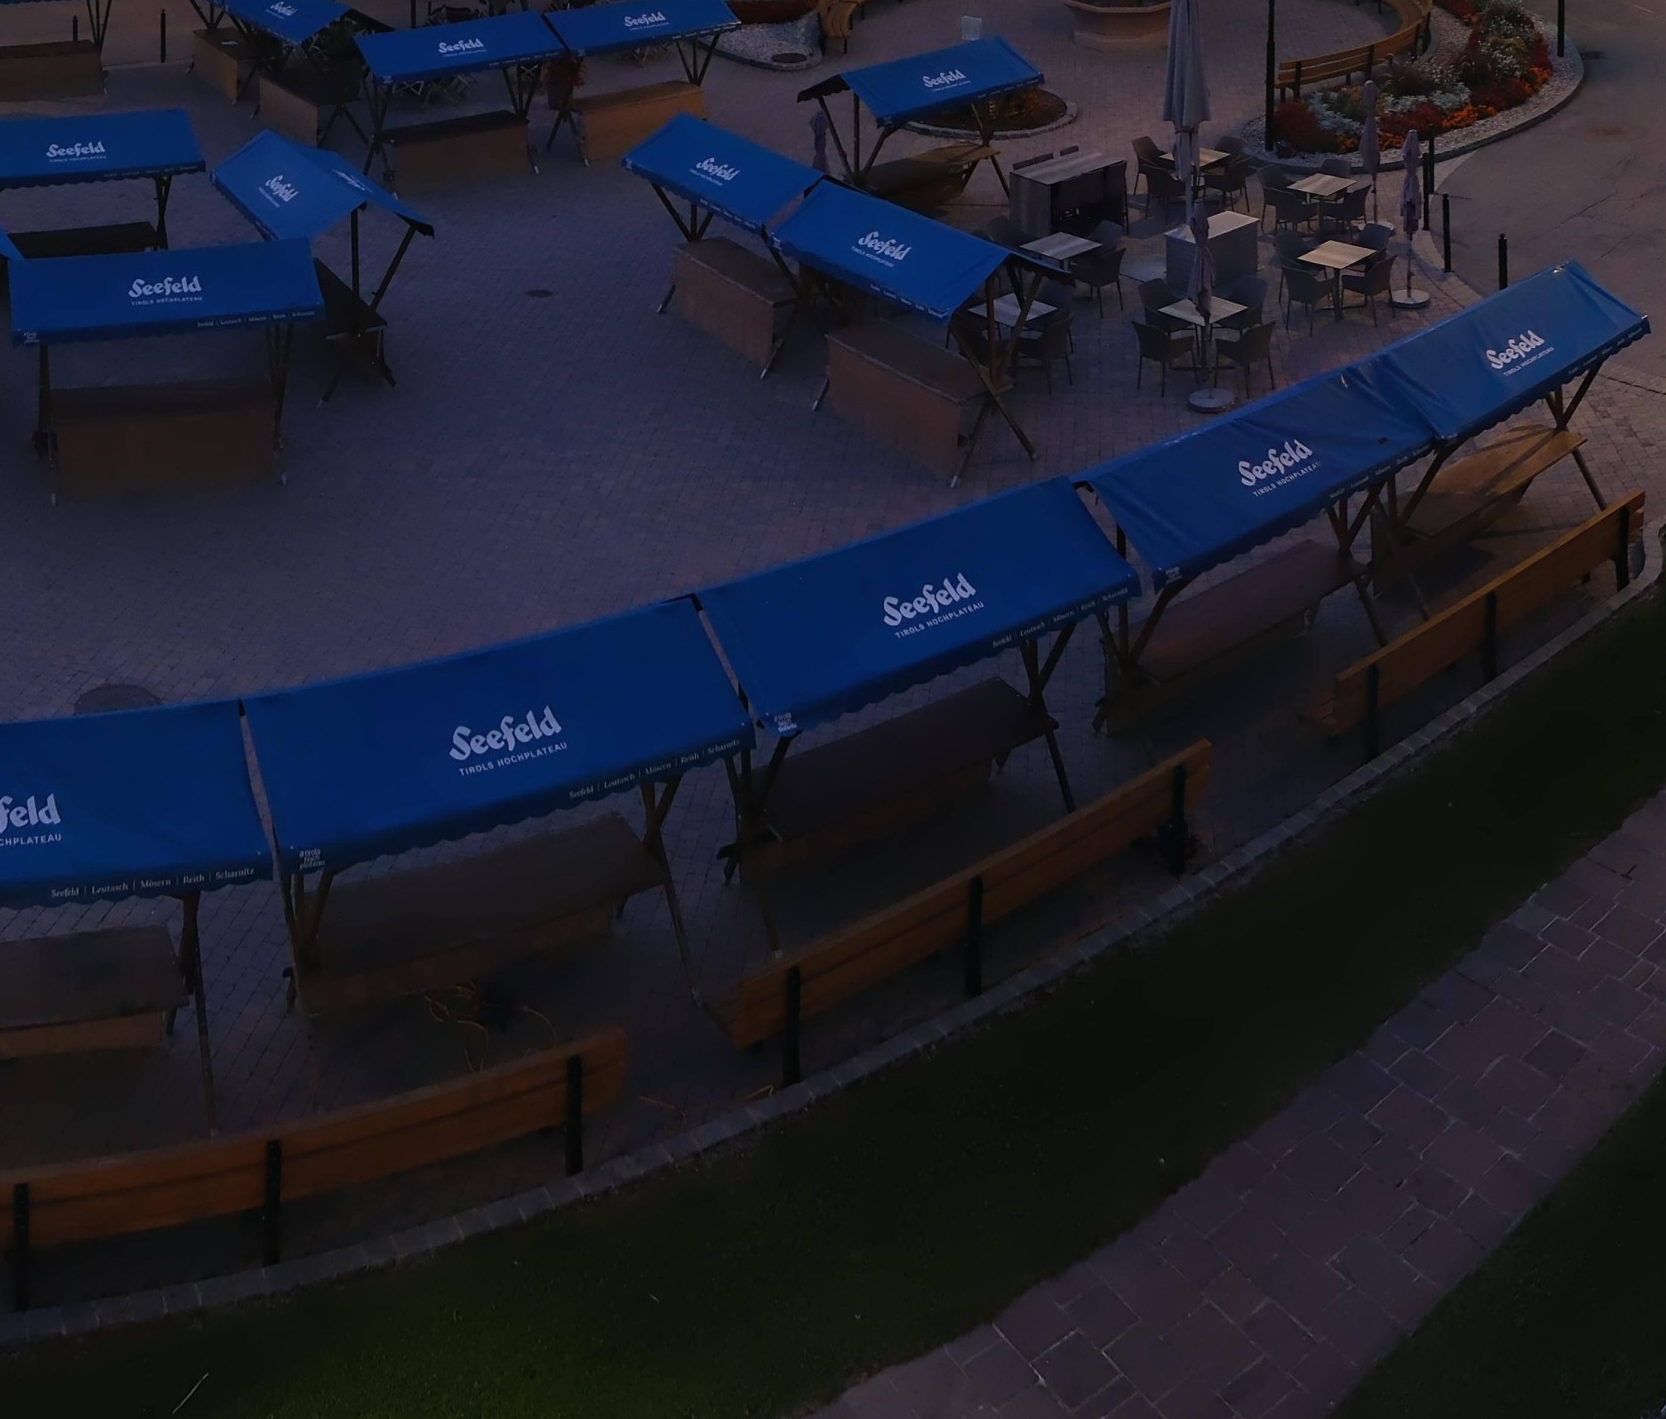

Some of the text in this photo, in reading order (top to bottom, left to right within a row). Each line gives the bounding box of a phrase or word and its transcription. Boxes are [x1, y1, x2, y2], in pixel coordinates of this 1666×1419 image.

[624, 11, 667, 27] Seefeld
[438, 38, 485, 53] Seefeld
[923, 69, 967, 88] Seefeld
[45, 141, 106, 157] Seefeld
[695, 157, 741, 181] Seefeld
[858, 231, 912, 261] Seefeld
[128, 275, 202, 298] Seefeld
[1486, 329, 1545, 370] Seefeld
[1238, 438, 1314, 487] Seefeld
[882, 571, 977, 627] Seefeld
[894, 622, 926, 641] TIROLS
[449, 704, 564, 762] Seefeld
[458, 741, 568, 779] TIROLS HOCHPLATEAU
[51, 866, 255, 898] Seefeld Leutasch Mösern Reith Scharnitz
